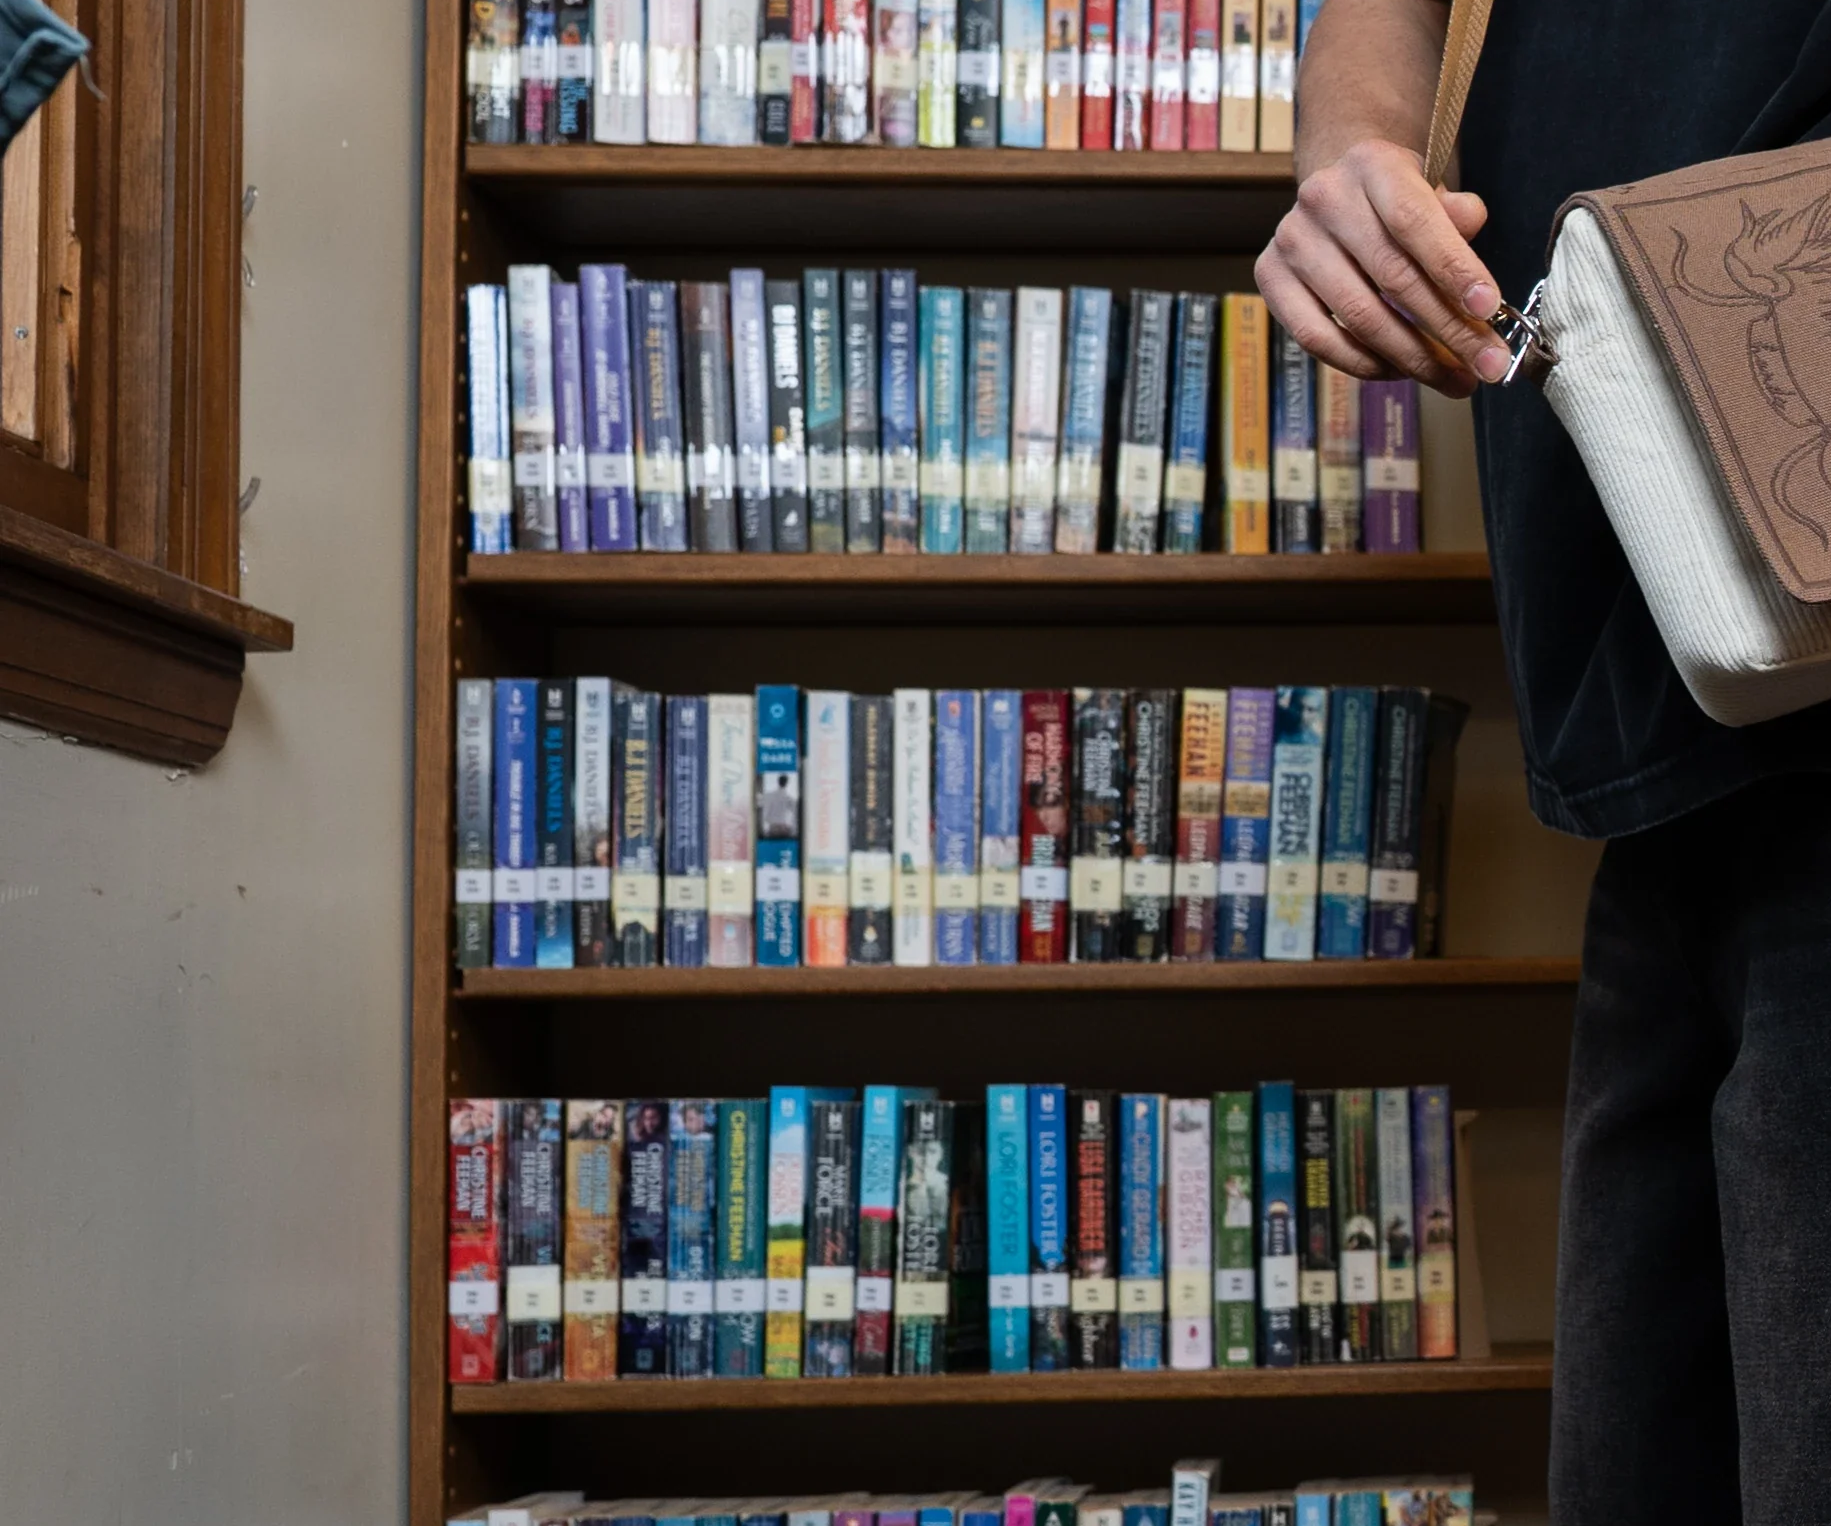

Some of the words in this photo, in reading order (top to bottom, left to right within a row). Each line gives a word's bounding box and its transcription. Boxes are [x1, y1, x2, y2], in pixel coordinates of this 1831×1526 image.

[474, 87, 490, 124] OOL
[1136, 701, 1152, 780] CHRISTINE
[1187, 702, 1210, 776] FEEHAN
[1233, 702, 1258, 776] FEEHAN
[1342, 698, 1359, 778] CHRISTINE
[1135, 783, 1149, 844] FEEHAN
[1191, 819, 1208, 863] LEOPA
[1236, 819, 1254, 863] LEOPA
[1278, 772, 1297, 855] FEEHAN
[1298, 772, 1313, 856] CHRISTINE
[1337, 782, 1353, 844] FEEHAN
[471, 1146, 488, 1218] CHRISTINE
[537, 1142, 553, 1215] CHRISTINE
[647, 1143, 663, 1214] CHRISTINE
[731, 1111, 746, 1192] CHRISTINE
[816, 1156, 833, 1217] FORCE
[998, 1131, 1019, 1176] LORI
[1040, 1131, 1055, 1176] LORI
[729, 1196, 744, 1261] FEEHAN
[907, 1215, 922, 1271] FOSTE
[1000, 1180, 1019, 1256] FOSTER
[1040, 1183, 1057, 1254] FOSTER
[1176, 1482, 1197, 1509] KAY
